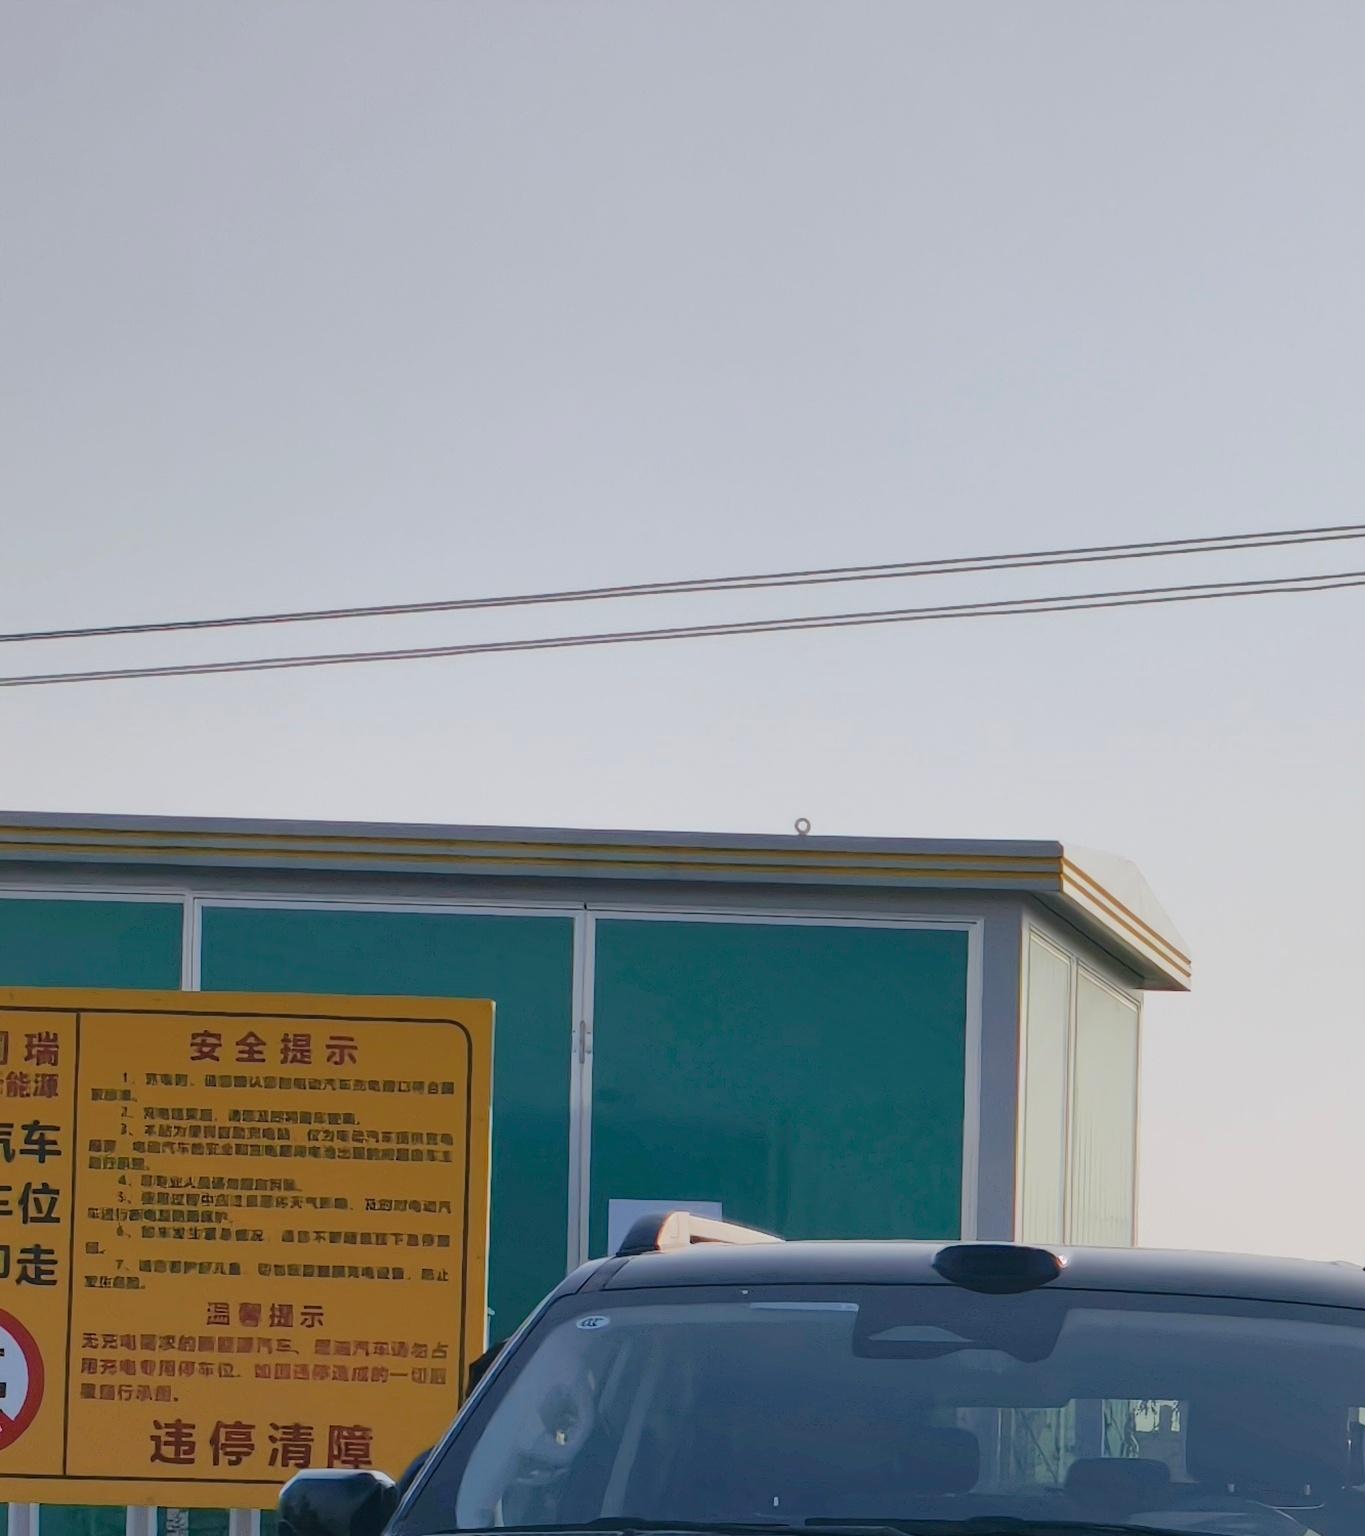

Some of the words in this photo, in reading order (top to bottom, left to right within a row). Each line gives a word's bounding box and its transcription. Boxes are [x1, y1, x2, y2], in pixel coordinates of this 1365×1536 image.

[0, 1031, 59, 1067] 瑞
[189, 1029, 360, 1066] 安全提示
[0, 1071, 59, 1099] 能源
[0, 1181, 61, 1225] 位
[0, 1243, 59, 1287] 走
[206, 1302, 327, 1329] 温馨提示
[149, 1418, 375, 1470] 违停清障
